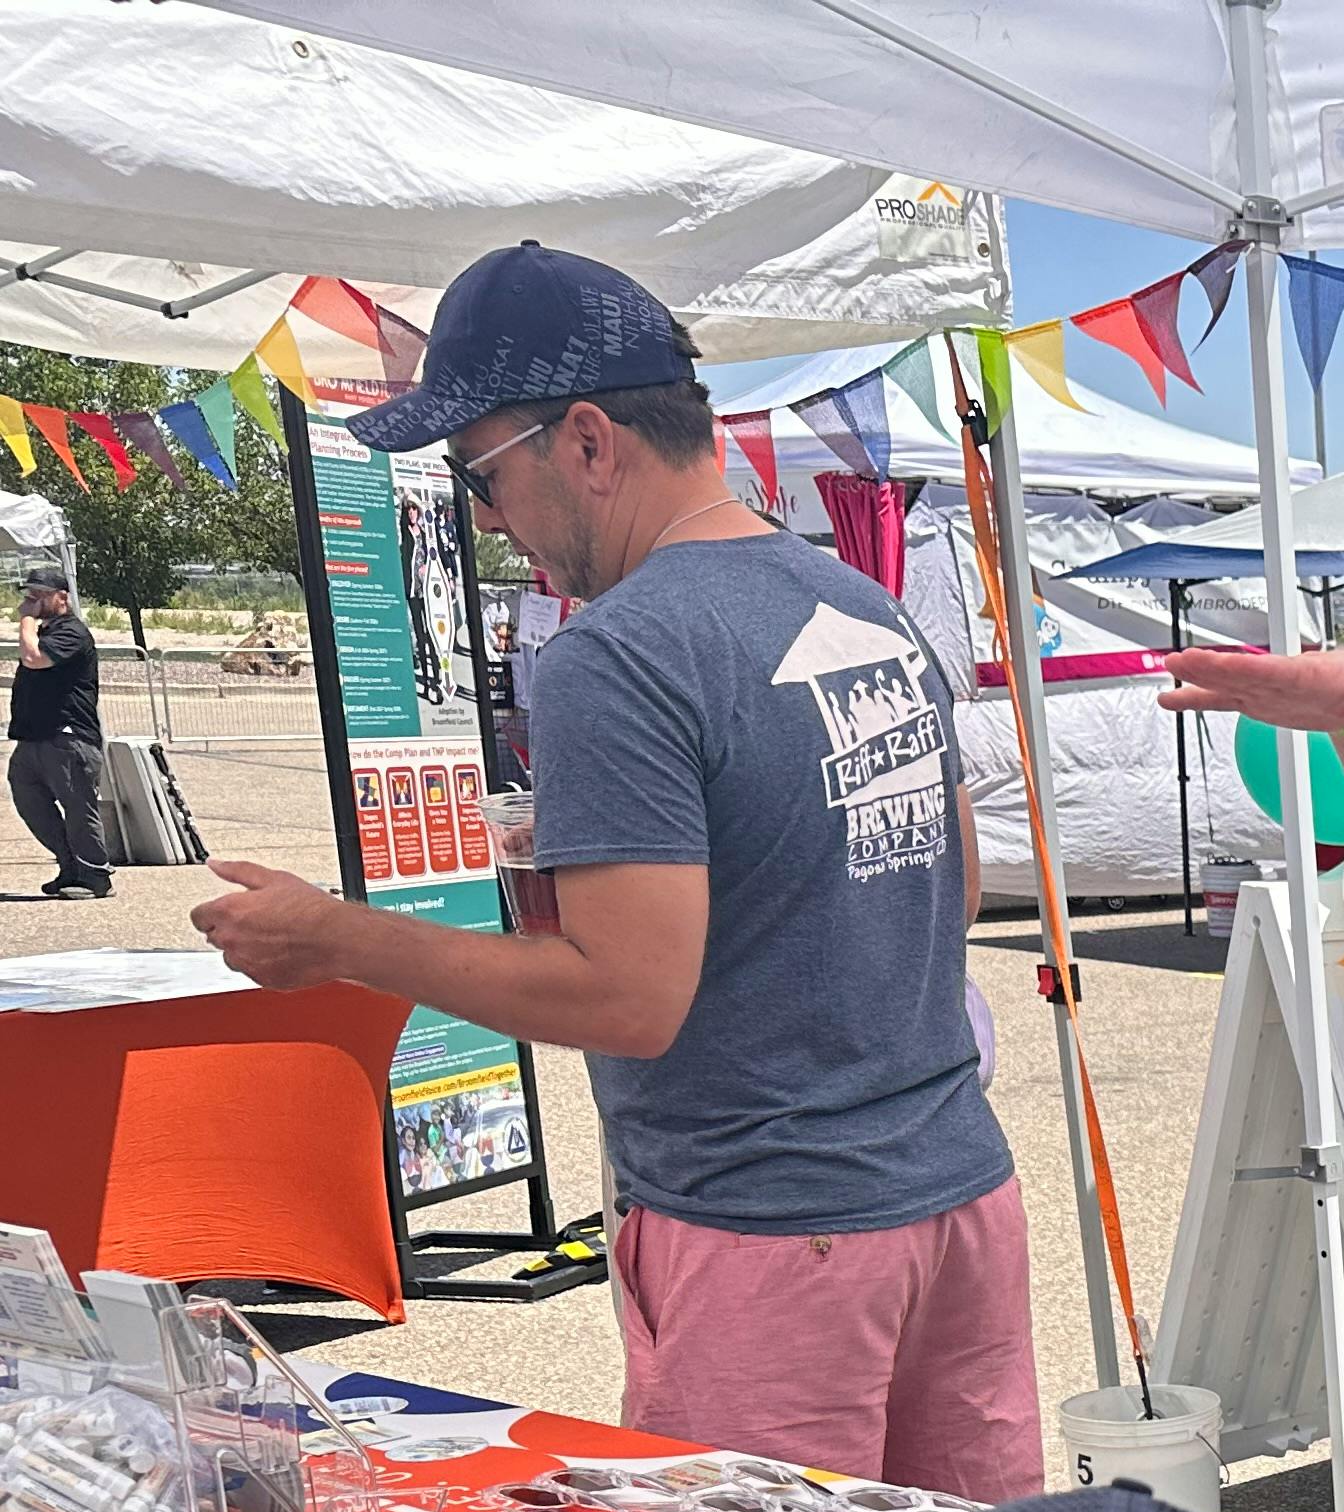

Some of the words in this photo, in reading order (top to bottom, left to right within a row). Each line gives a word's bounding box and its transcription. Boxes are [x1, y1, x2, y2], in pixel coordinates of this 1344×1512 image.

[875, 199, 965, 226] PROSHADE
[601, 293, 622, 356] MAUI
[311, 443, 341, 457] Planning
[342, 445, 368, 459] Process
[1190, 596, 1267, 612] MBROIDER
[836, 743, 872, 796] Riff
[885, 713, 936, 768] Raff
[846, 783, 946, 841] BREWING
[847, 822, 947, 861] COMPANY
[1077, 1453, 1094, 1486] 5
